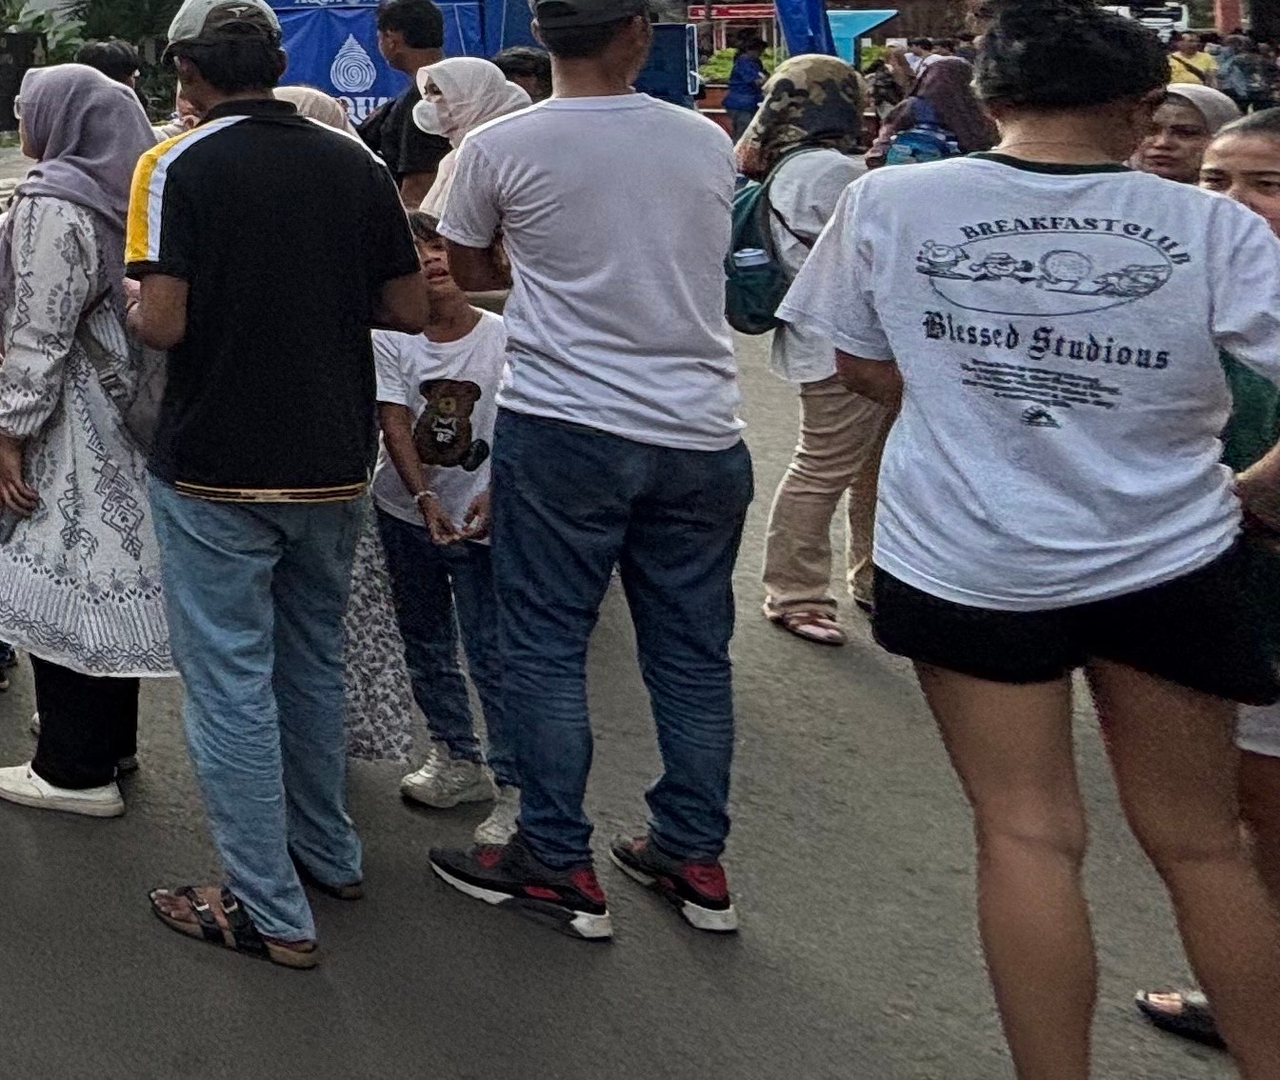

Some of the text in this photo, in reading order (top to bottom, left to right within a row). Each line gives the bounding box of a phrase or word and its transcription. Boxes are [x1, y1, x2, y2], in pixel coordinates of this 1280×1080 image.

[958, 216, 1192, 266] BREAKFAST CLUB
[922, 310, 1021, 351] Blessed
